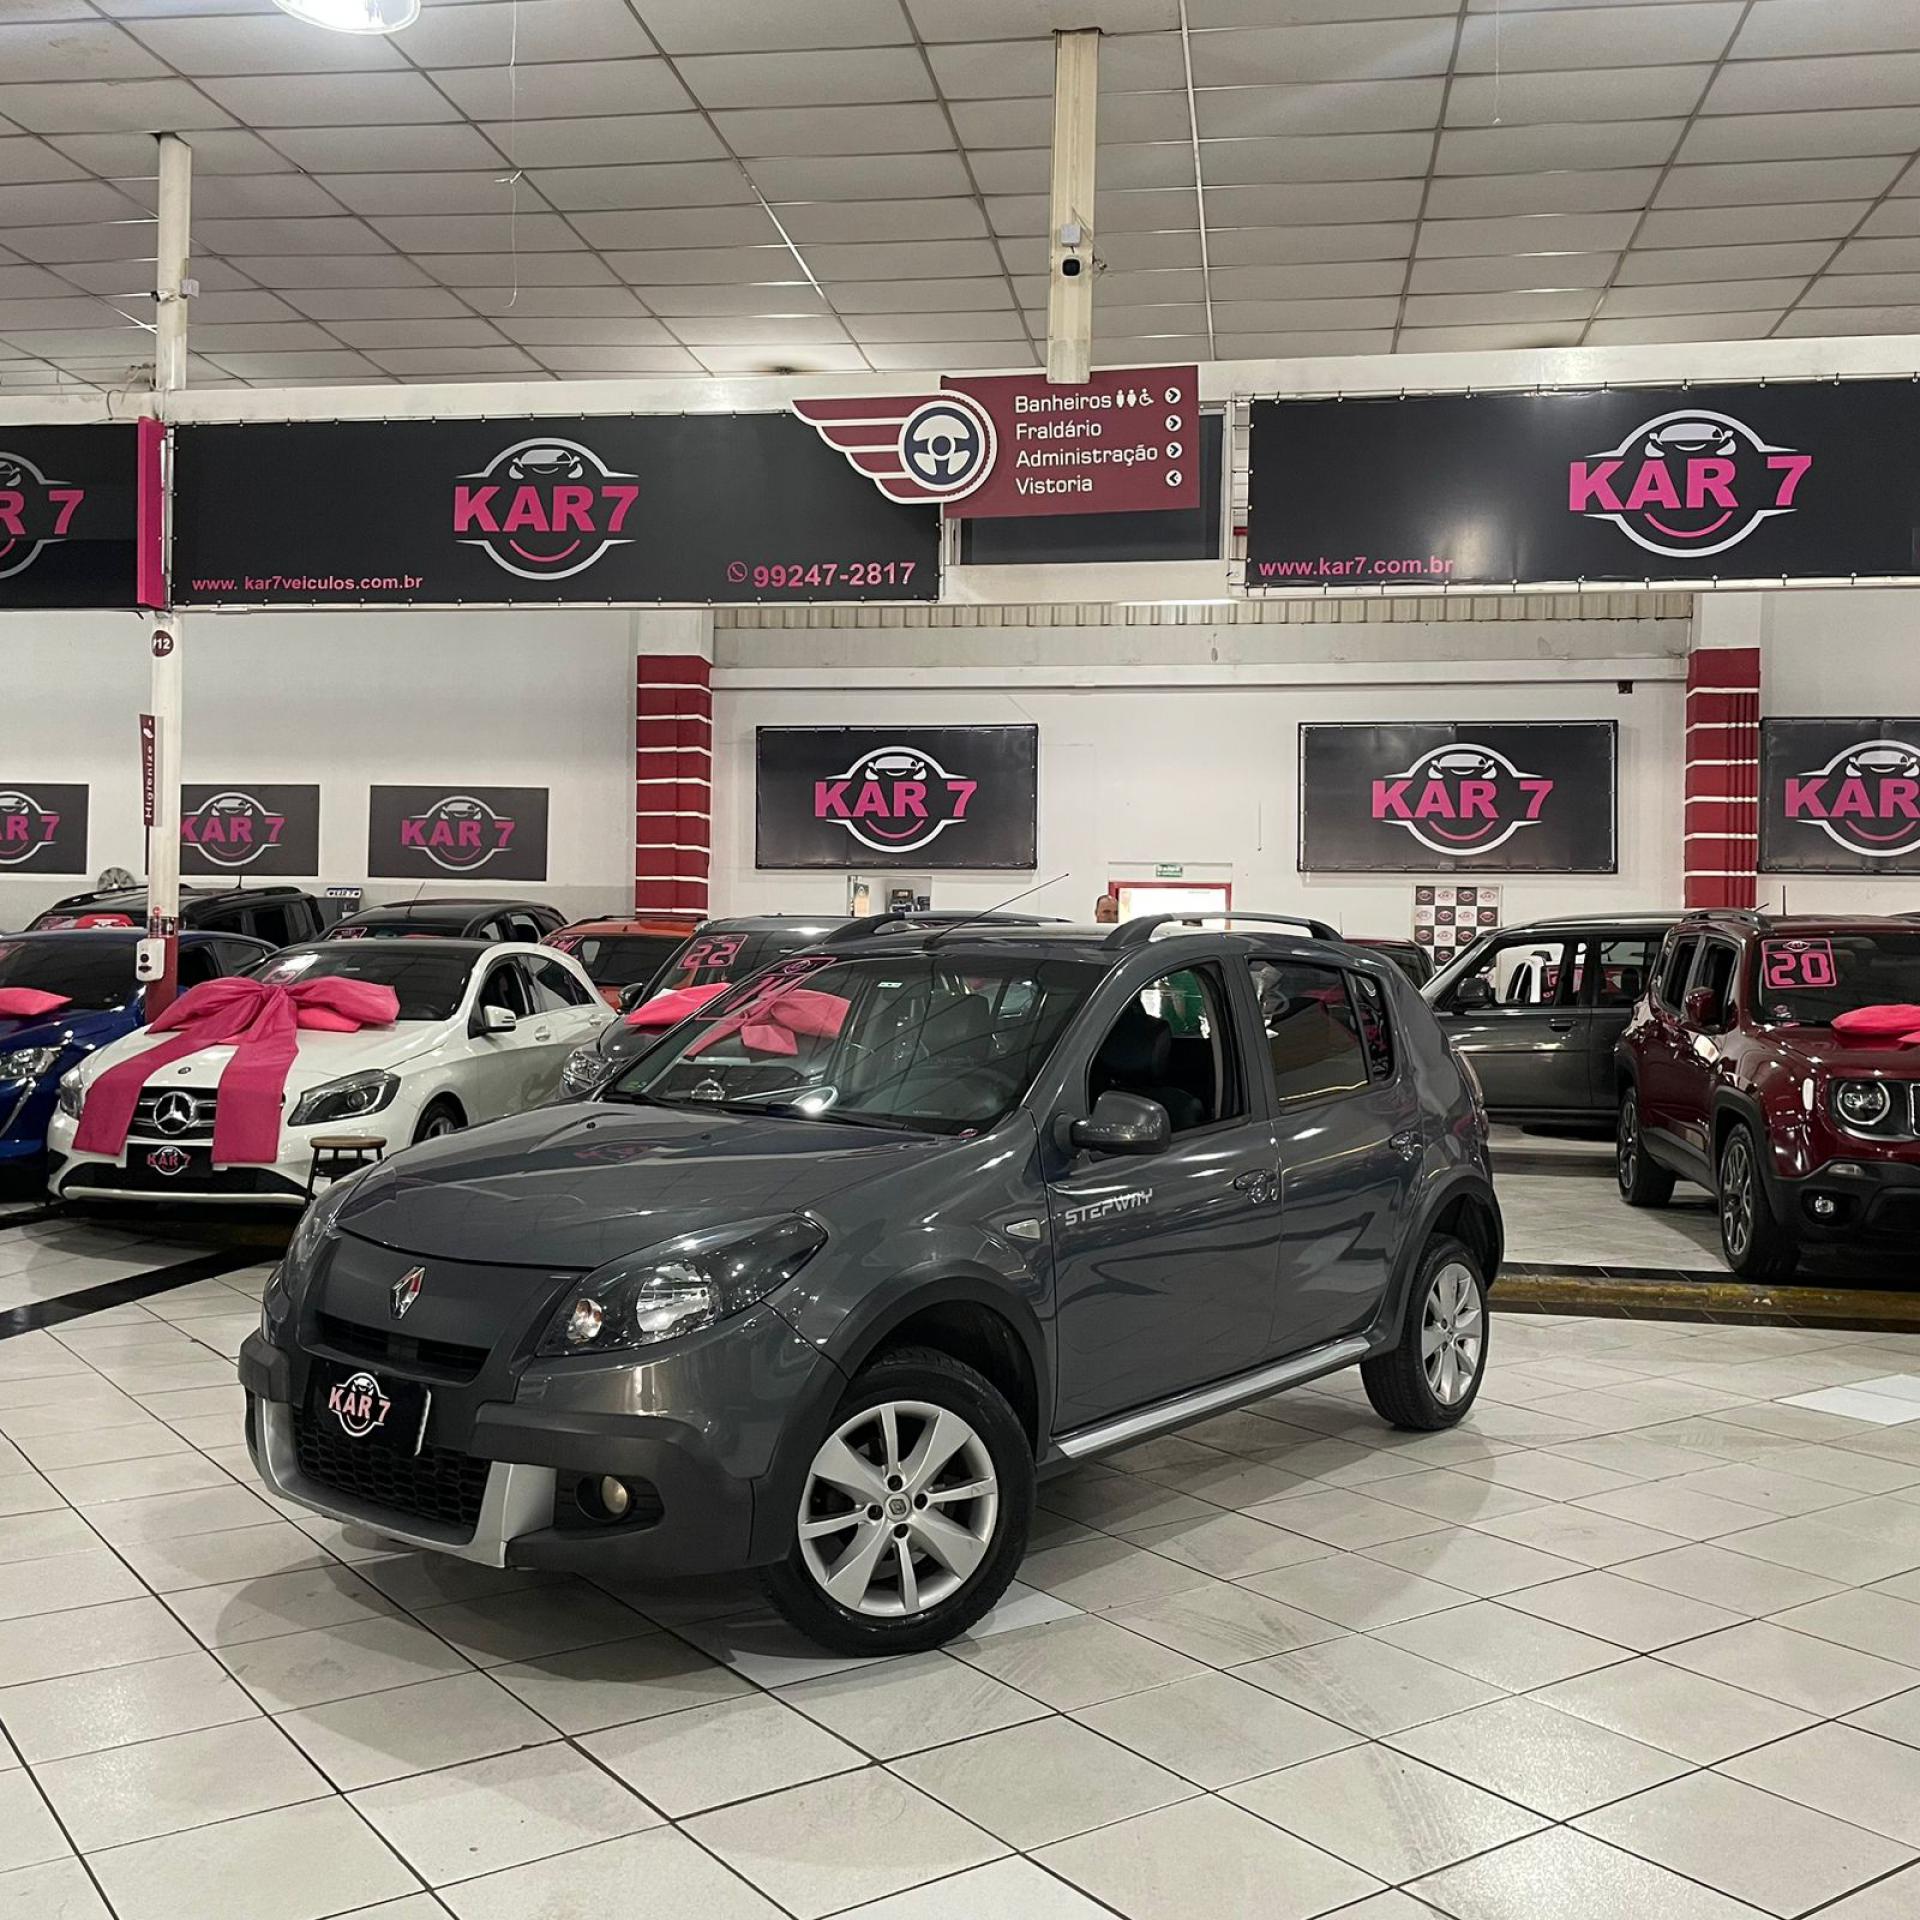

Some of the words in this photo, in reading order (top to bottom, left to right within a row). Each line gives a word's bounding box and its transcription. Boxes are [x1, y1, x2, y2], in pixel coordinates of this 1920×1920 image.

[1015, 393, 1112, 413] Banheiros
[1016, 420, 1102, 440] Fraldário
[1016, 445, 1158, 468] Administração
[1016, 475, 1093, 495] Vistoria
[1569, 458, 1739, 511] KAR
[1766, 455, 1812, 506] 7
[753, 562, 916, 588] 99247-2817
[1258, 556, 1453, 576] www.kar7.com.br
[244, 575, 423, 590] kar7veiculos.com.br
[815, 781, 929, 818] KAR
[946, 781, 978, 818] 7
[1372, 780, 1500, 819] KAR
[1519, 780, 1554, 819] 7
[1784, 778, 1920, 818] KAR
[264, 817, 286, 843] 7
[401, 820, 482, 846] KAR
[494, 821, 516, 847] 7
[683, 941, 738, 968] 22
[1770, 953, 1831, 985] 20
[146, 1154, 178, 1168] KAR
[1064, 1187, 1153, 1226] STEPWAY
[328, 1386, 373, 1420] KAR
[378, 1399, 391, 1423] 7
